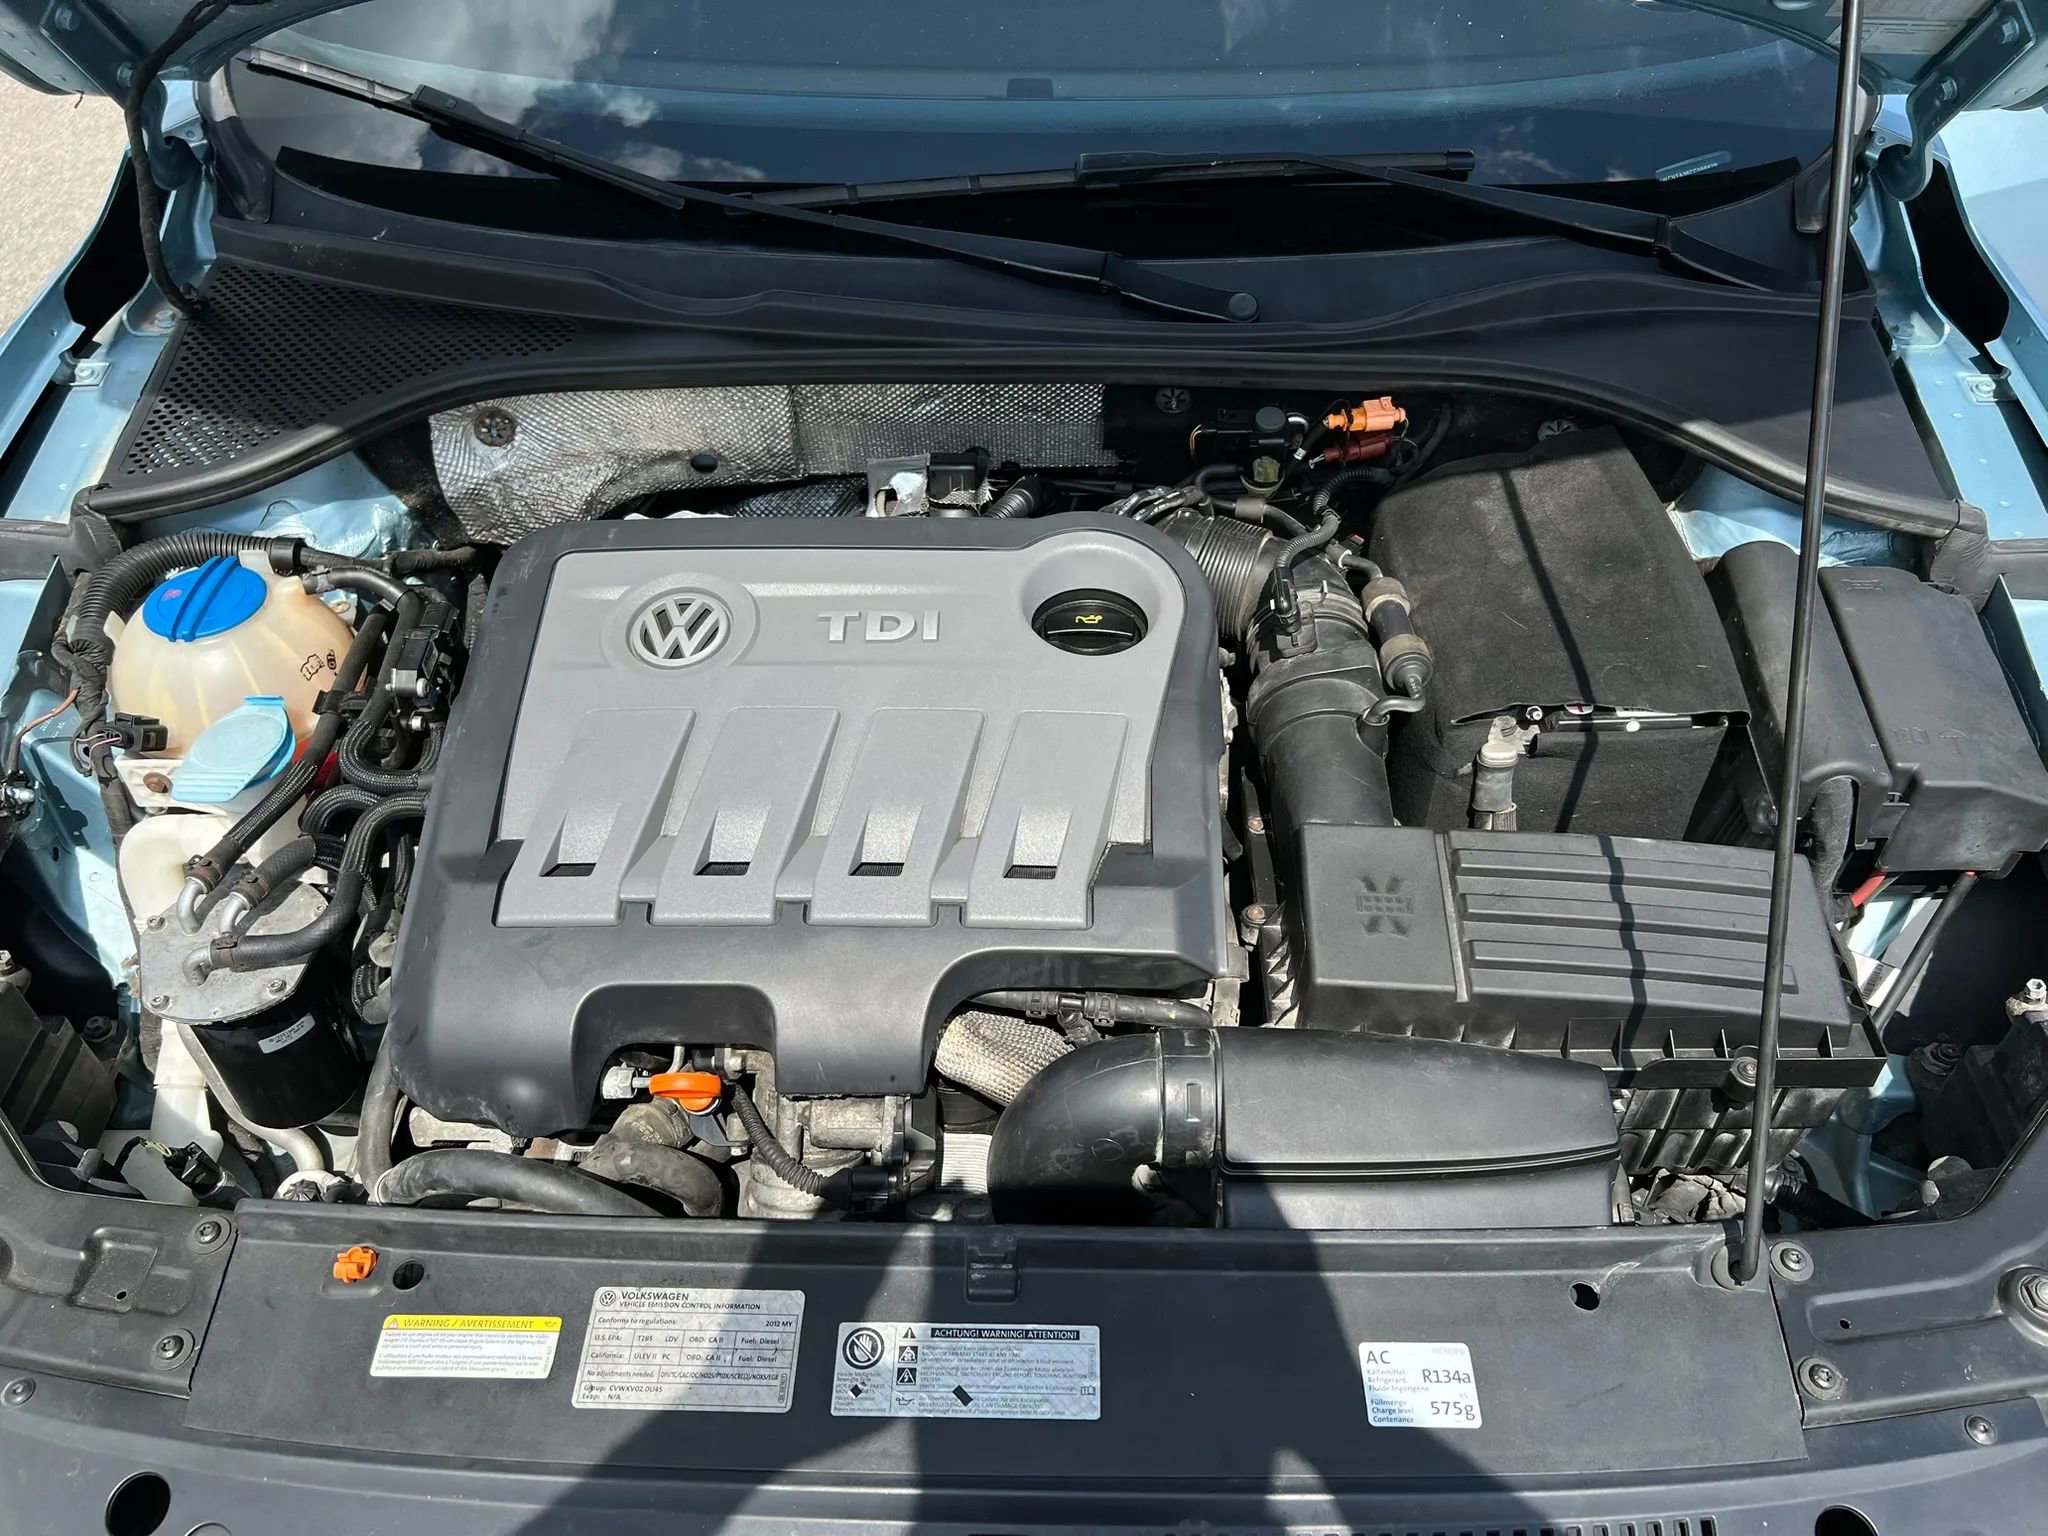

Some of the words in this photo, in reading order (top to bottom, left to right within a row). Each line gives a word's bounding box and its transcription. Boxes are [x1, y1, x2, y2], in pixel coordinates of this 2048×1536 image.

[817, 609, 941, 643] TDI
[621, 1291, 690, 1301] VOLKSWAGEN
[713, 1302, 761, 1310] INFORMATION
[403, 1319, 450, 1328] WARNING
[460, 1319, 536, 1329] AVERTISSEMENT
[766, 1320, 781, 1328] 2012
[782, 1320, 793, 1328] MY
[934, 1329, 979, 1338] ACHTUNG!
[981, 1329, 1025, 1338] WARNING!
[1027, 1330, 1077, 1339] ATTENTION!
[665, 1335, 679, 1343] LDV
[740, 1337, 756, 1345] Fuel:
[759, 1337, 780, 1345] Diesel
[757, 1355, 777, 1363] Diesel
[1422, 1368, 1472, 1384] R134a
[1372, 1407, 1397, 1415] Charge
[1373, 1415, 1414, 1423] Contenance
